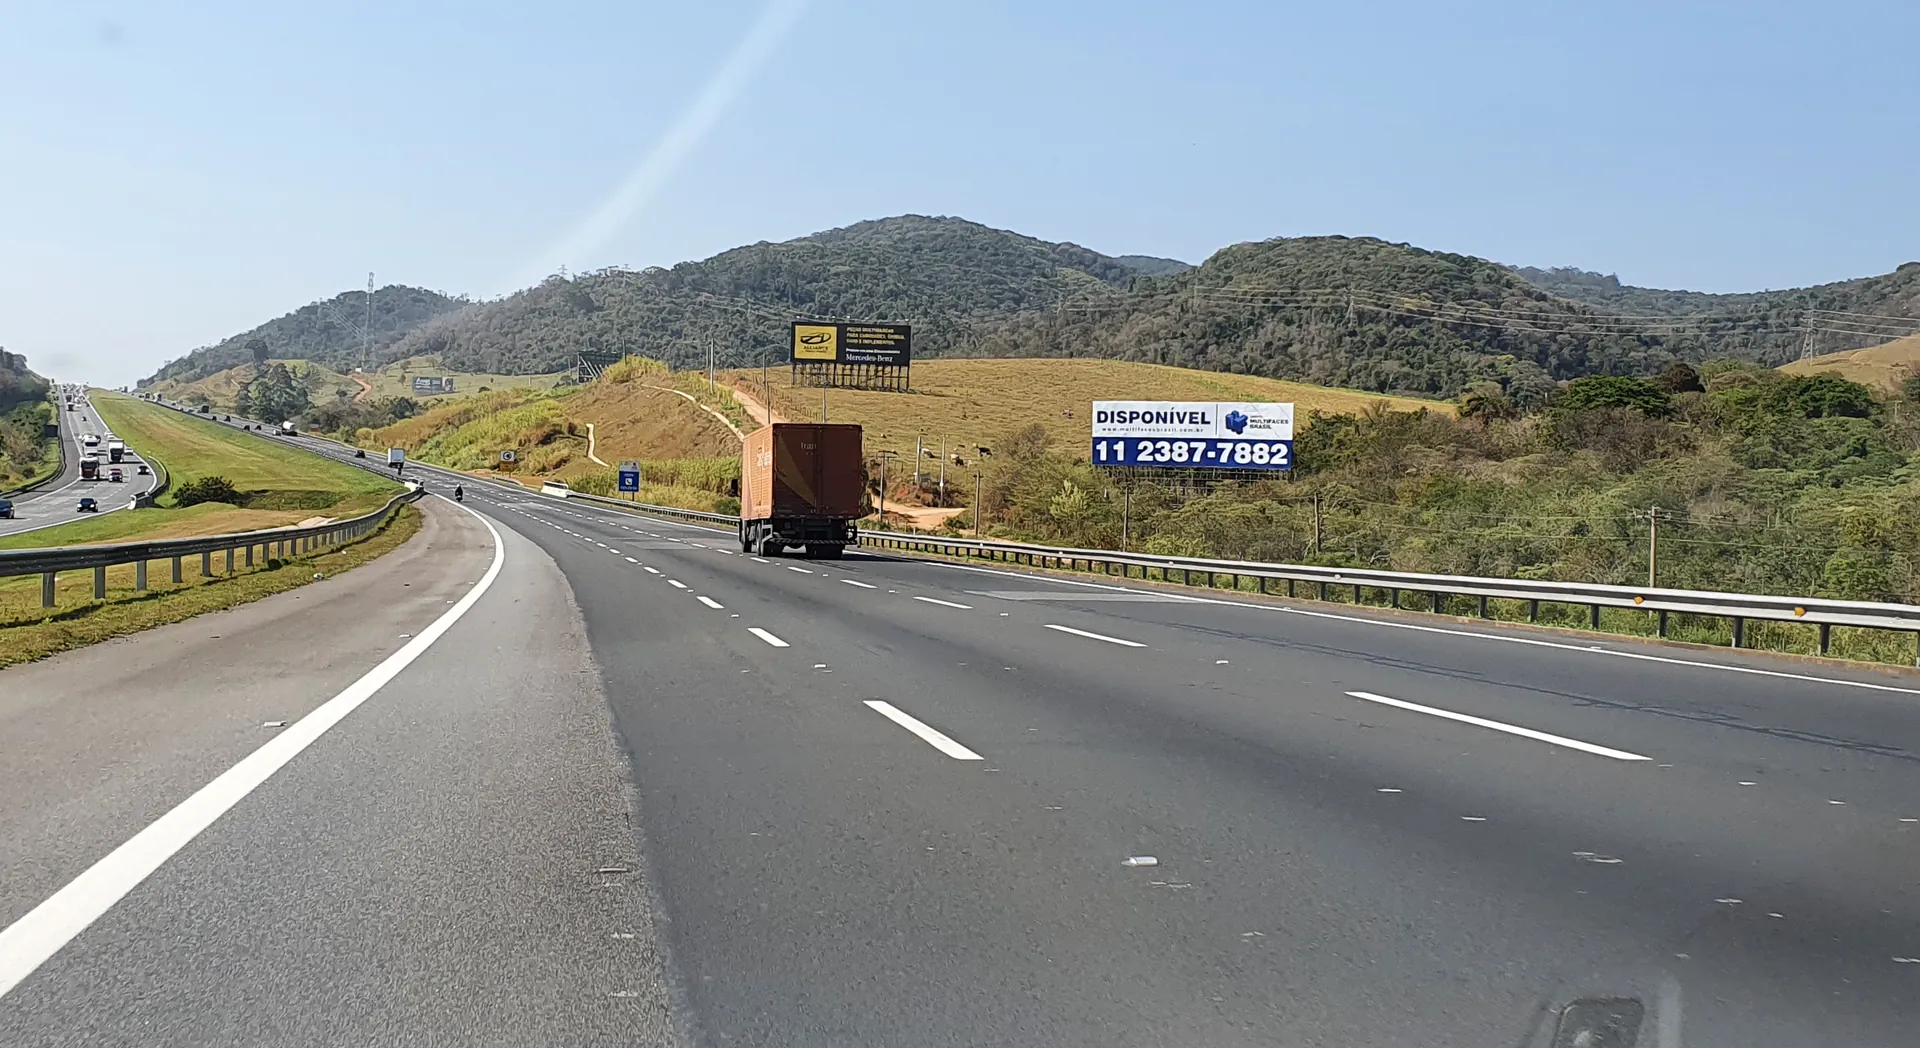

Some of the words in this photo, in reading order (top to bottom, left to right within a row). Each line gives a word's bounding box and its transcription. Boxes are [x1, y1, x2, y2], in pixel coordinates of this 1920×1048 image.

[846, 353, 893, 362] Mercedes-Benz
[1096, 407, 1211, 425] DISPONÍVEL
[1096, 441, 1125, 462] 11
[1136, 441, 1289, 465] 2387-7882
